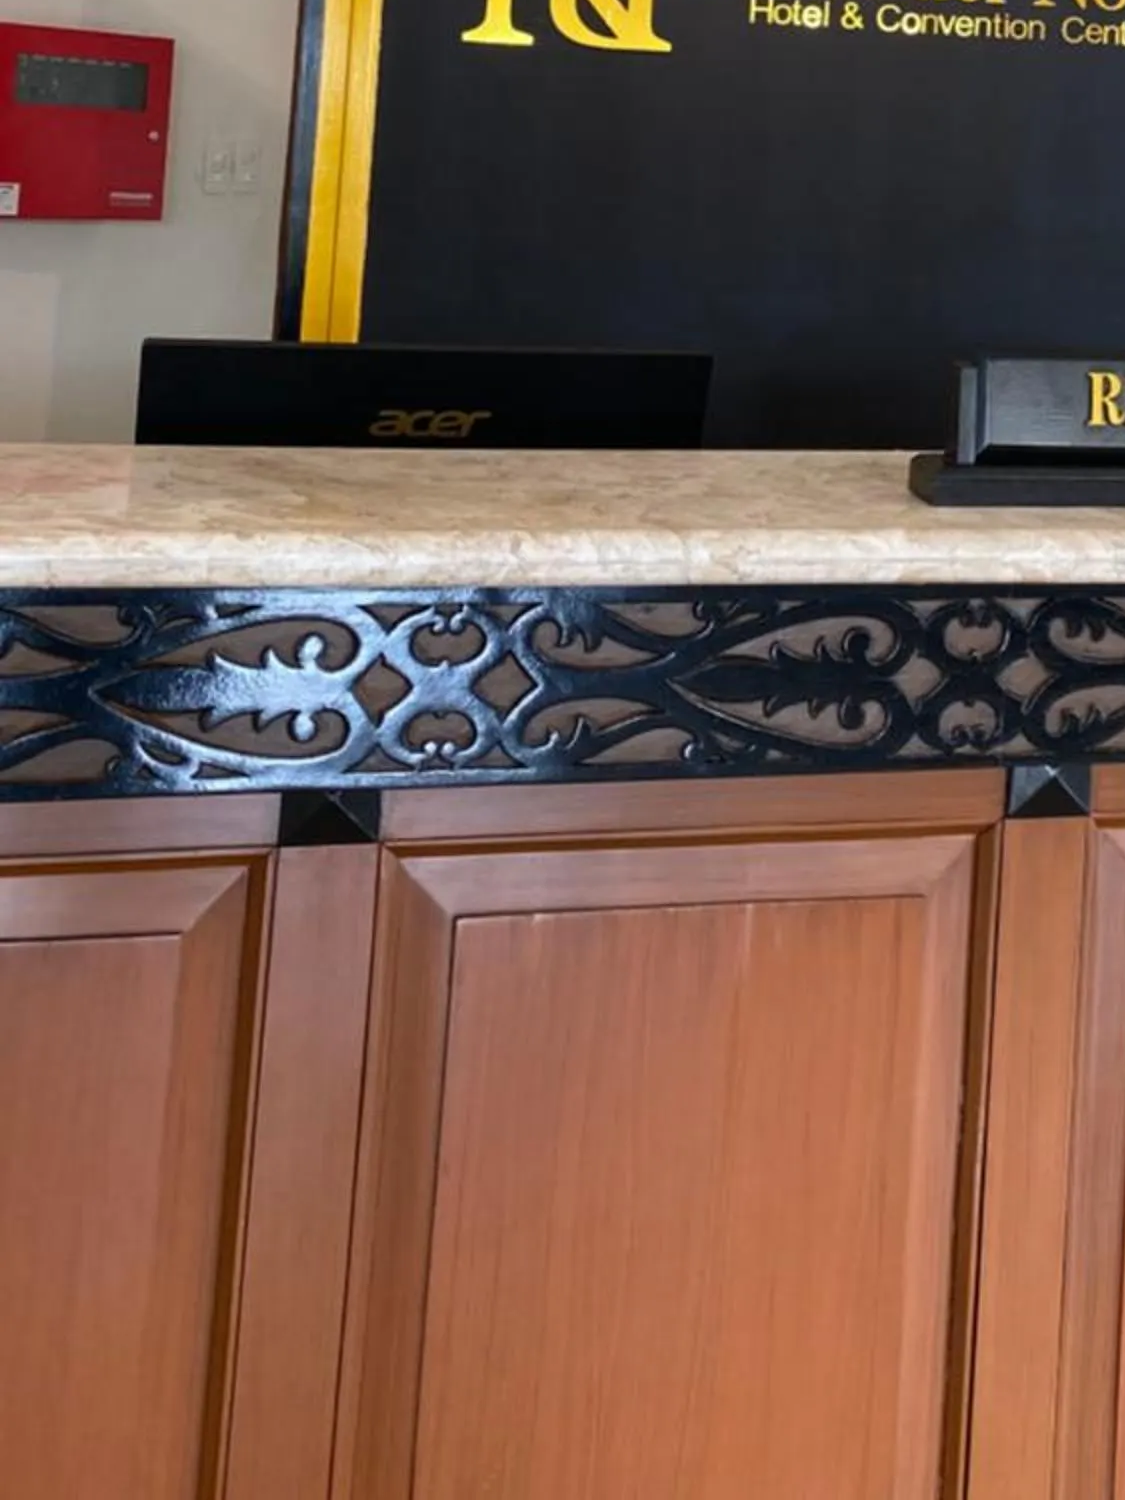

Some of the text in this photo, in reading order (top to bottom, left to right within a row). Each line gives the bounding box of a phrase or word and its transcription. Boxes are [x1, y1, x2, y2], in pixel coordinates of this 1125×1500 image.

[840, 1, 865, 31] &
[876, 4, 1046, 42] Convention
[368, 409, 492, 438] acer
